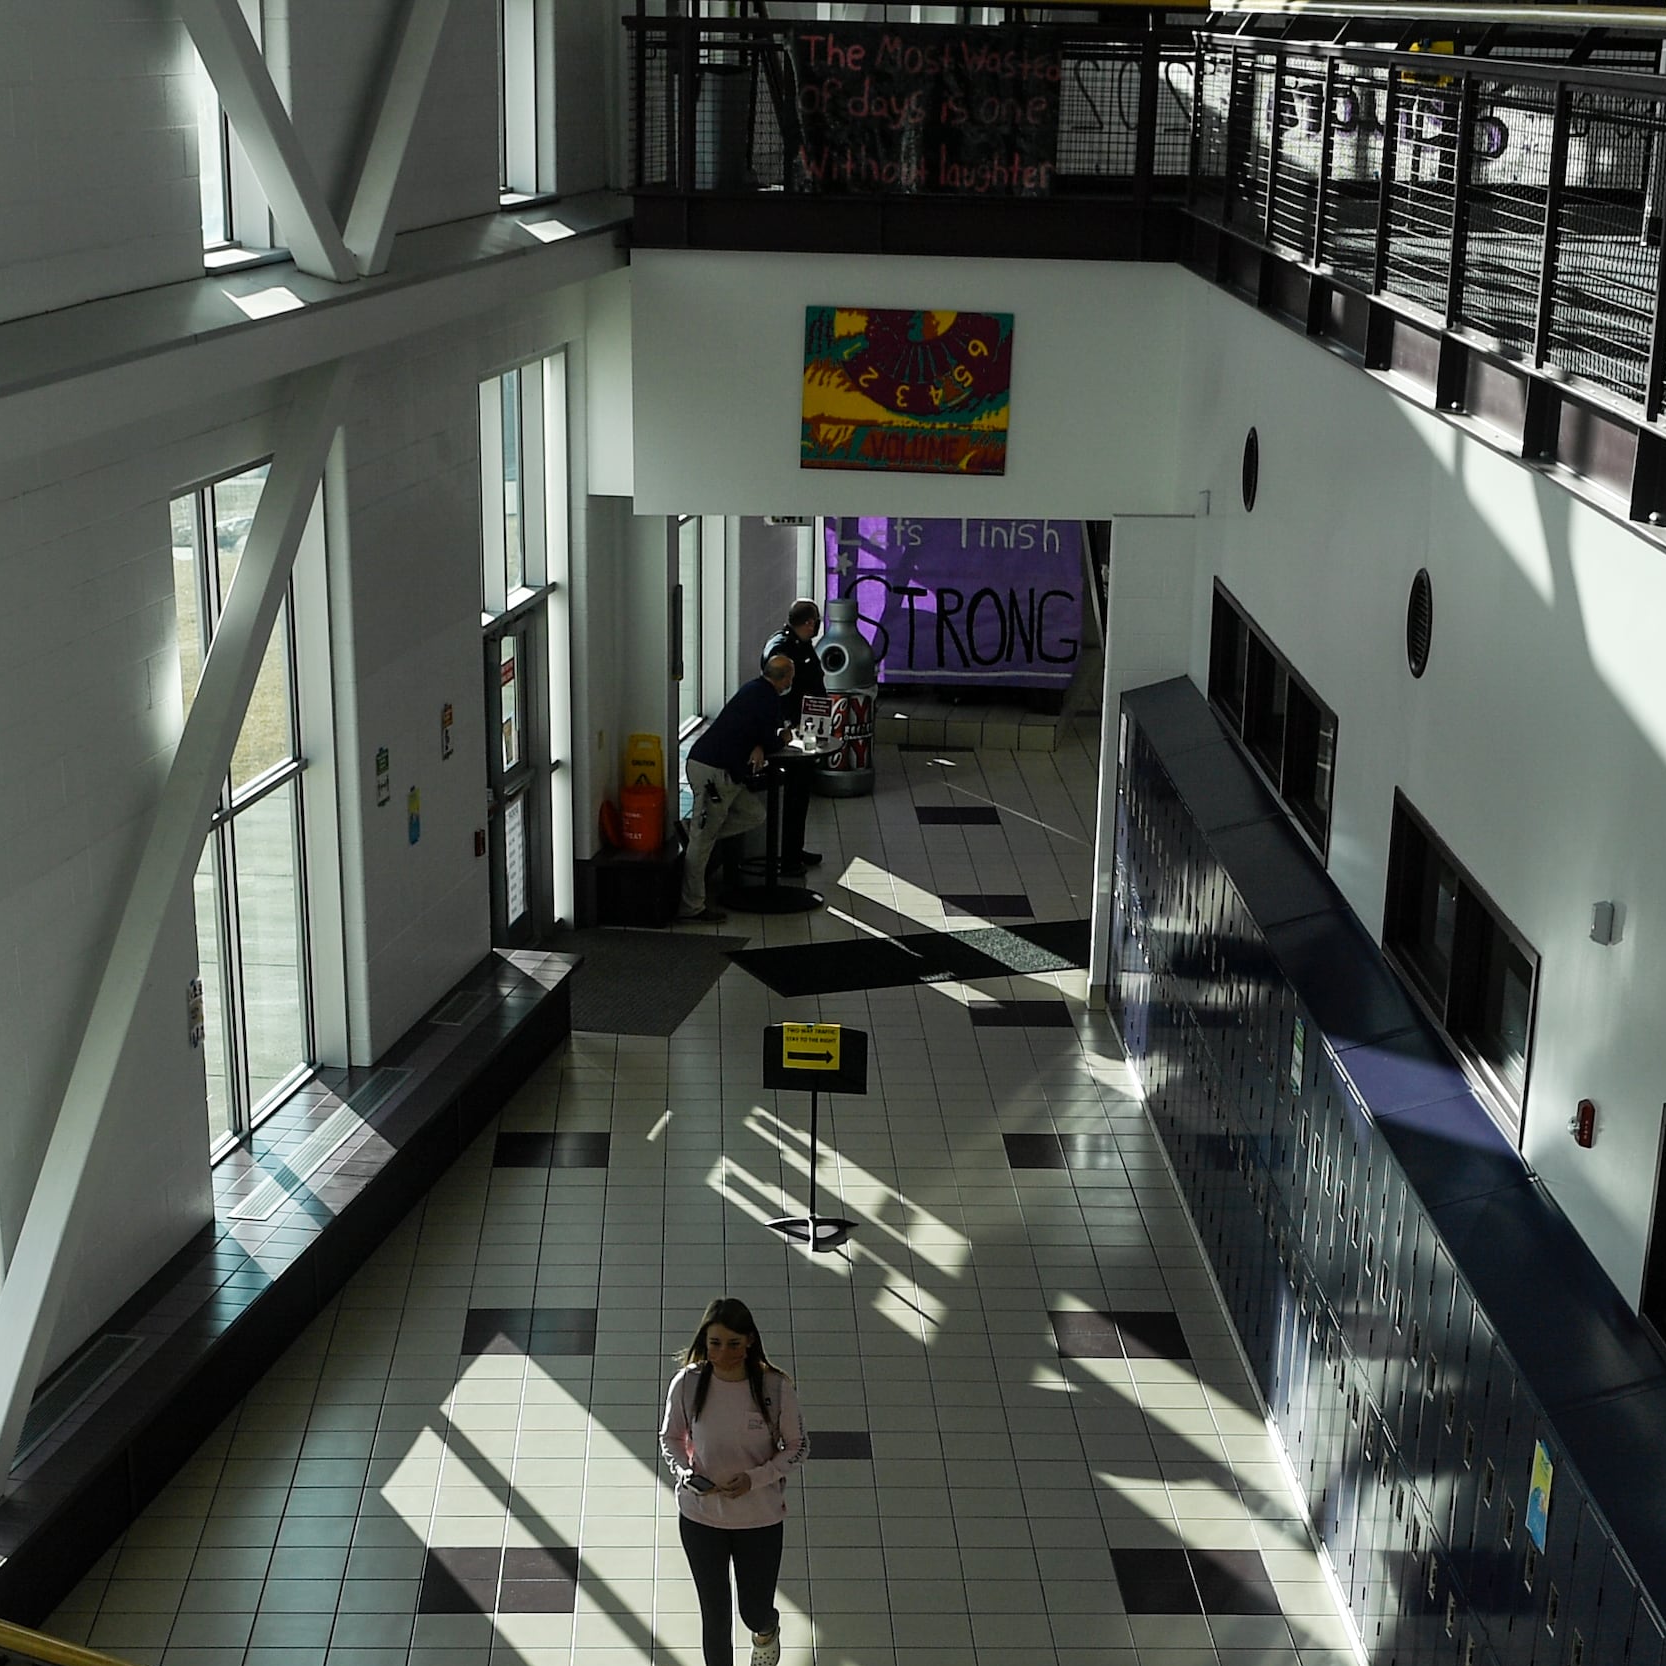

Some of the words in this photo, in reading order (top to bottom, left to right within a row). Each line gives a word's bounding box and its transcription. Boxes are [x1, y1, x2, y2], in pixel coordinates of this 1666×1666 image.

[799, 32, 866, 71] The
[874, 33, 952, 76] Most
[848, 75, 926, 130] days
[981, 96, 1048, 126] one
[939, 143, 1057, 192] laughter
[869, 431, 958, 461] VOLUME
[844, 575, 1078, 668] STRONG
